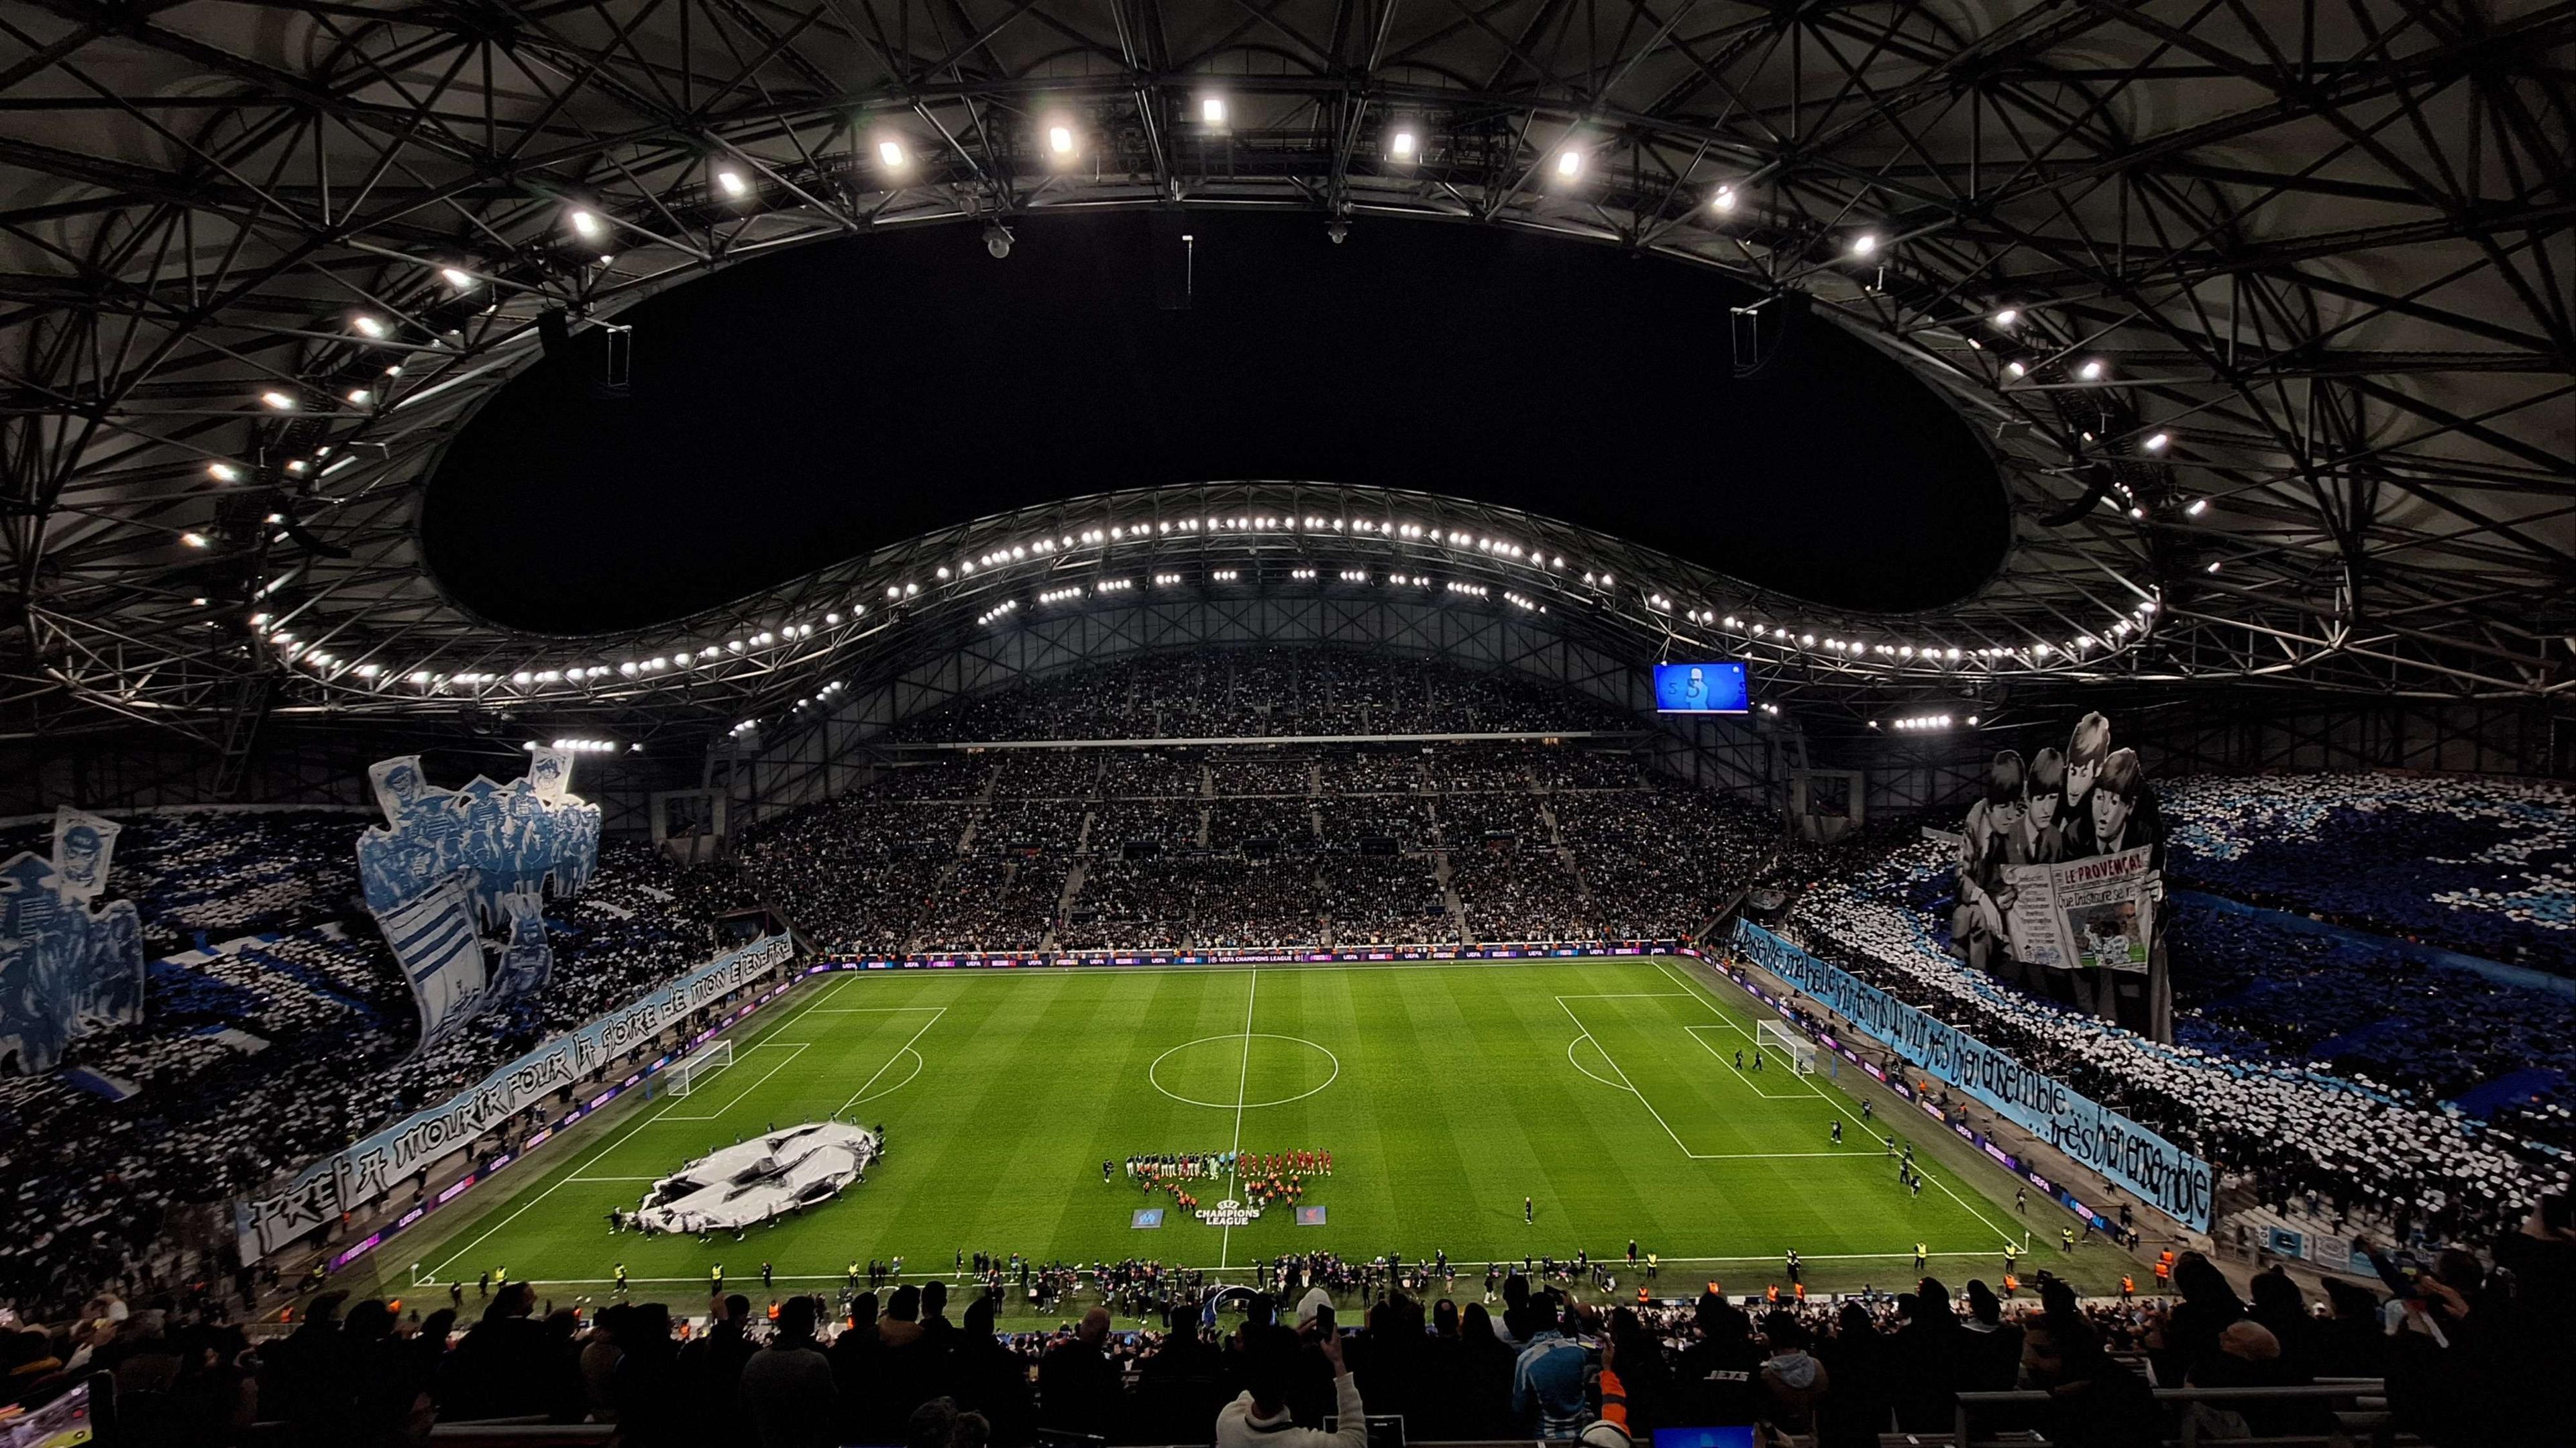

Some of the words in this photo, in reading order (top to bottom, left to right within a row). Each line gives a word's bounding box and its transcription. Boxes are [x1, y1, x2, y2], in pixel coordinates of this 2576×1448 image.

[2065, 870, 2076, 883] LE
[1894, 1082, 1910, 1098] UEFA
[1955, 1123, 1973, 1140] UEFA
[490, 1154, 510, 1172] UEFA
[2029, 1172, 2051, 1193] UEFA
[398, 1208, 424, 1228] UEFA
[1195, 1209, 1260, 1218] CHAMPIONS
[1205, 1217, 1249, 1225] LEAGUE
[1703, 1370, 1750, 1382] JETS
